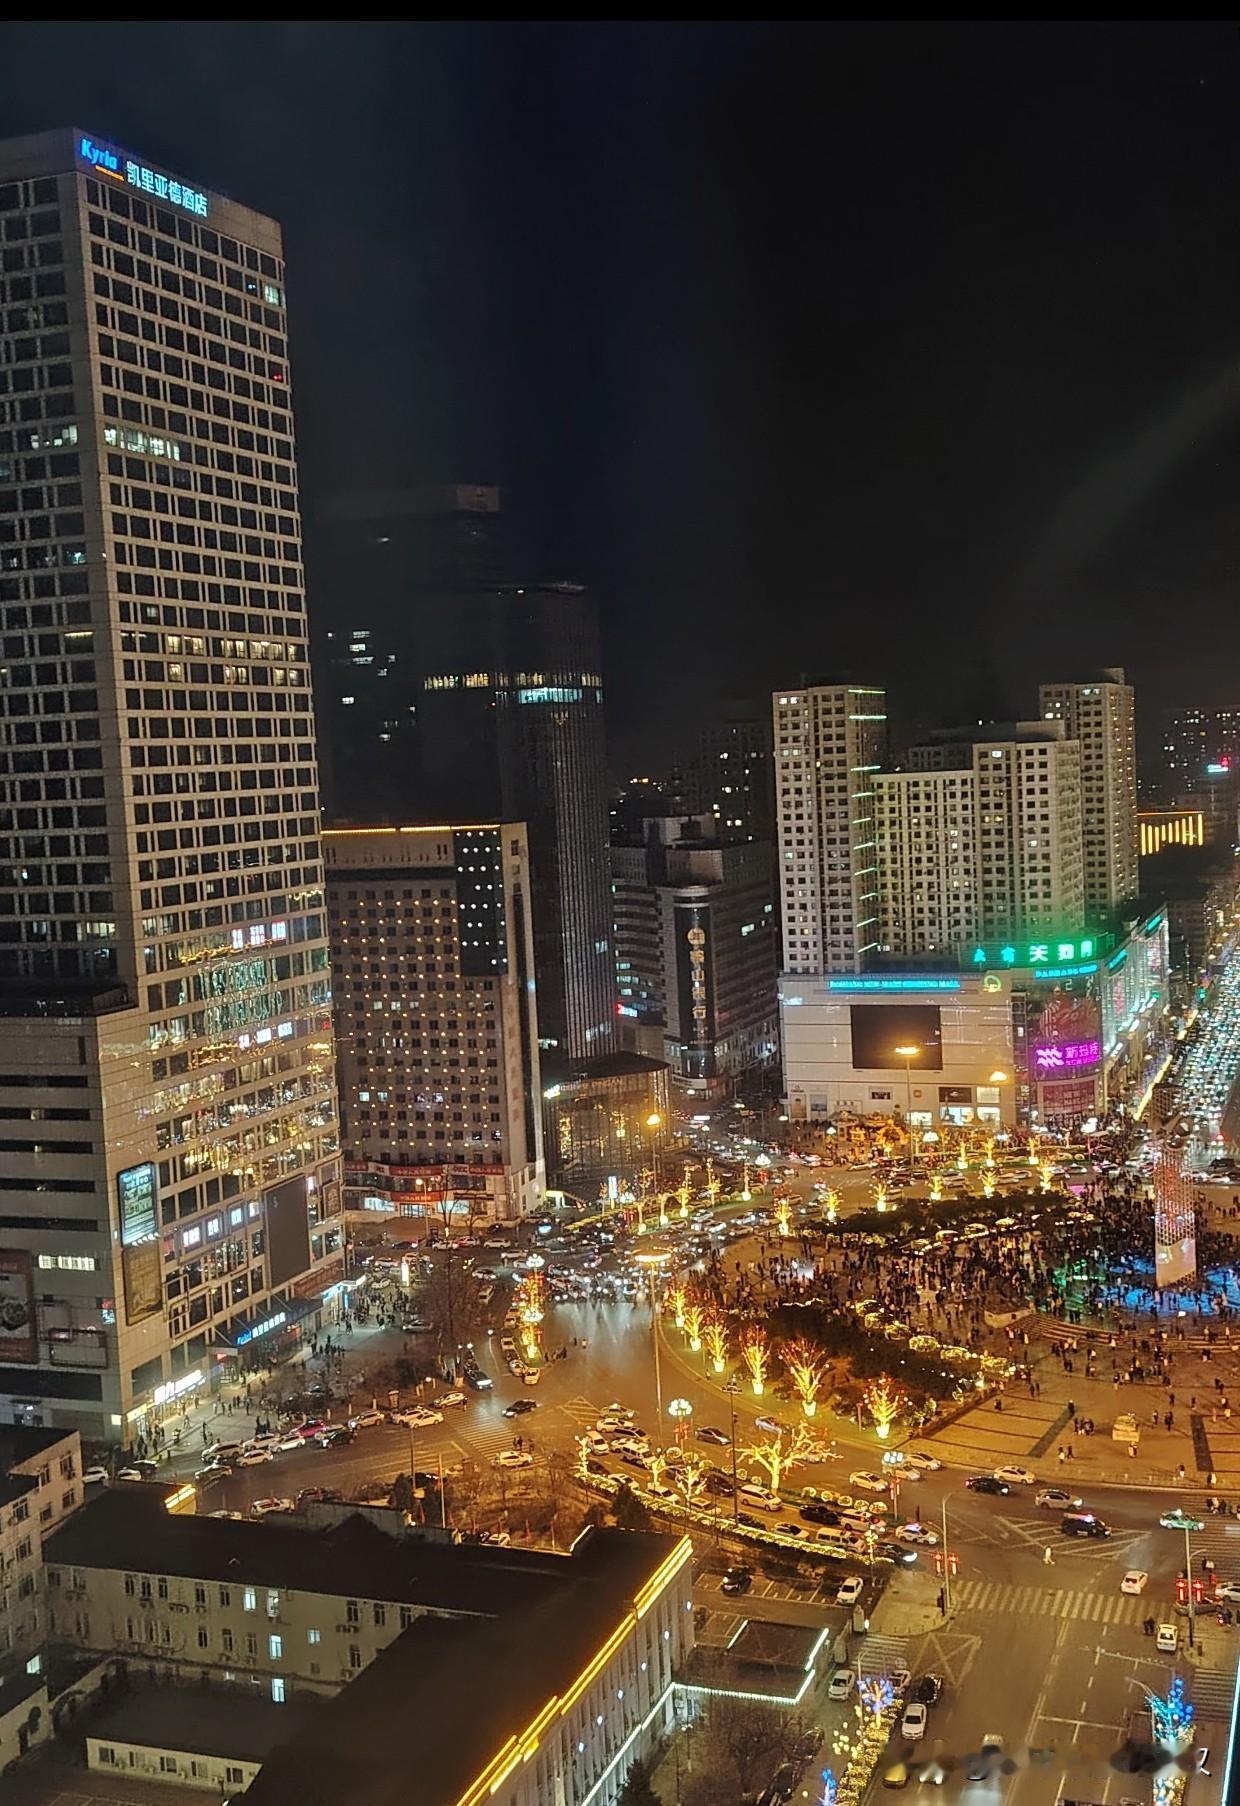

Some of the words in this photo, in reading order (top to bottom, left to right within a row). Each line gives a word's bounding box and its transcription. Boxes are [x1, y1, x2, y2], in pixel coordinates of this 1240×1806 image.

[126, 160, 208, 218] 凯里亚德酒店
